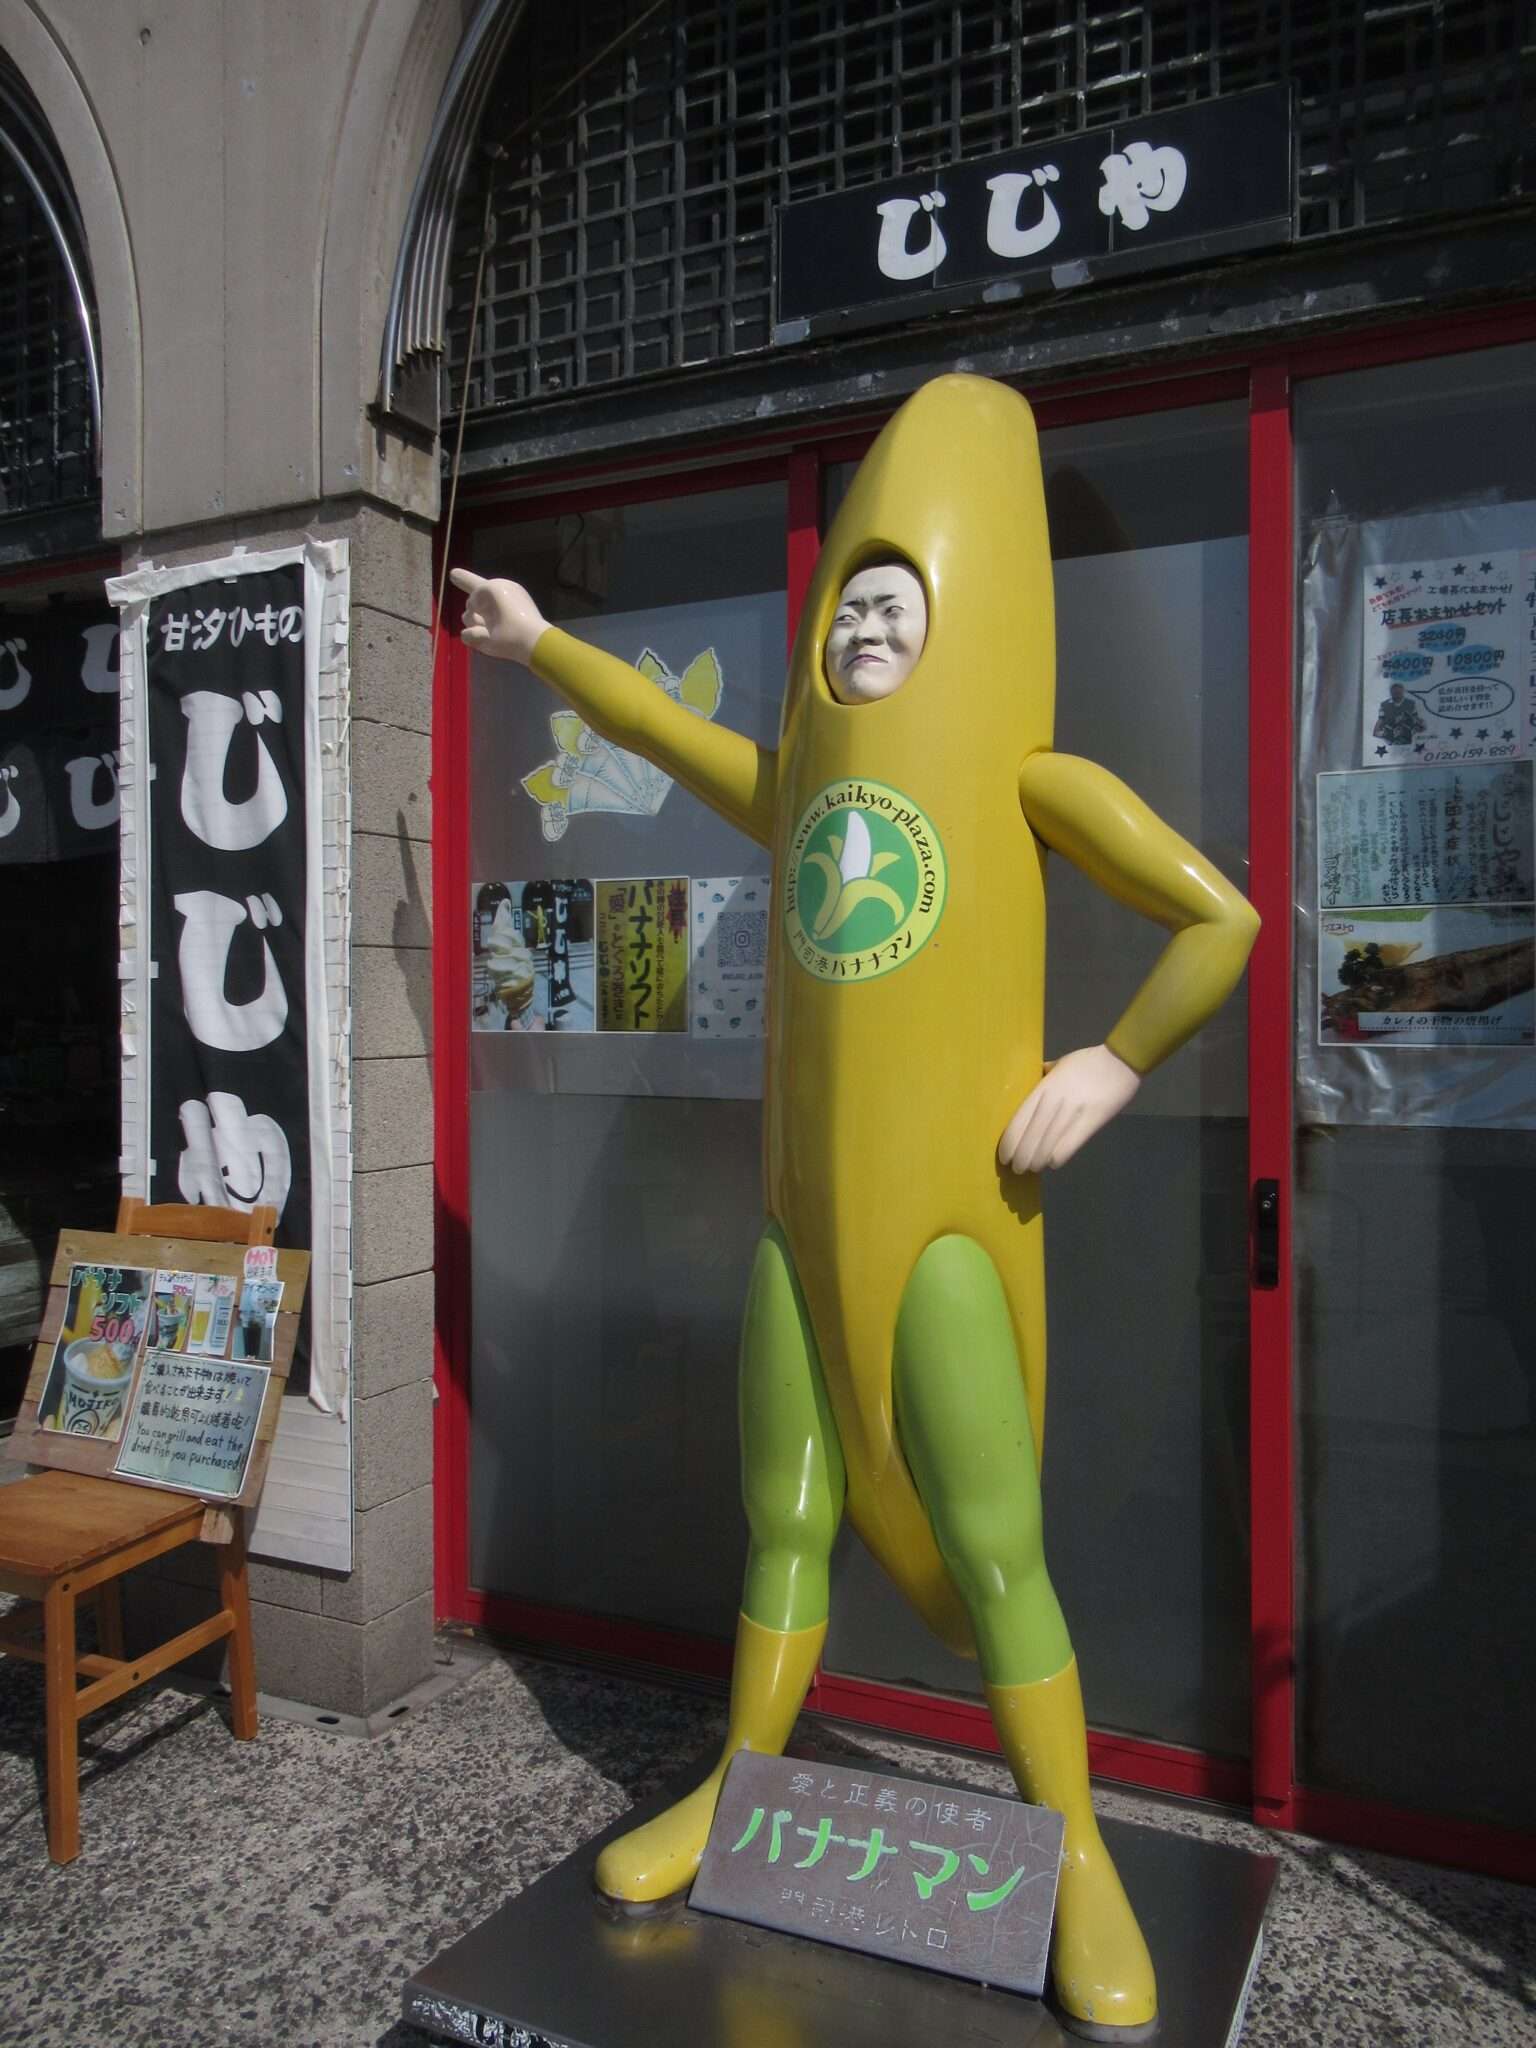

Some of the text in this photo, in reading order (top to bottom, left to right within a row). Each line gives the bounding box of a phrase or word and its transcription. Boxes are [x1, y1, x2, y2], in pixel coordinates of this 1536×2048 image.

[877, 141, 1187, 280] じじや
[160, 604, 305, 651] 甘汐ひもの
[628, 879, 654, 1029] バナナソフト
[131, 1437, 151, 1452] dried
[171, 1450, 186, 1463] you
[137, 1422, 243, 1451] You can grill and eat the
[787, 1772, 993, 1833] 愛と正義の使者
